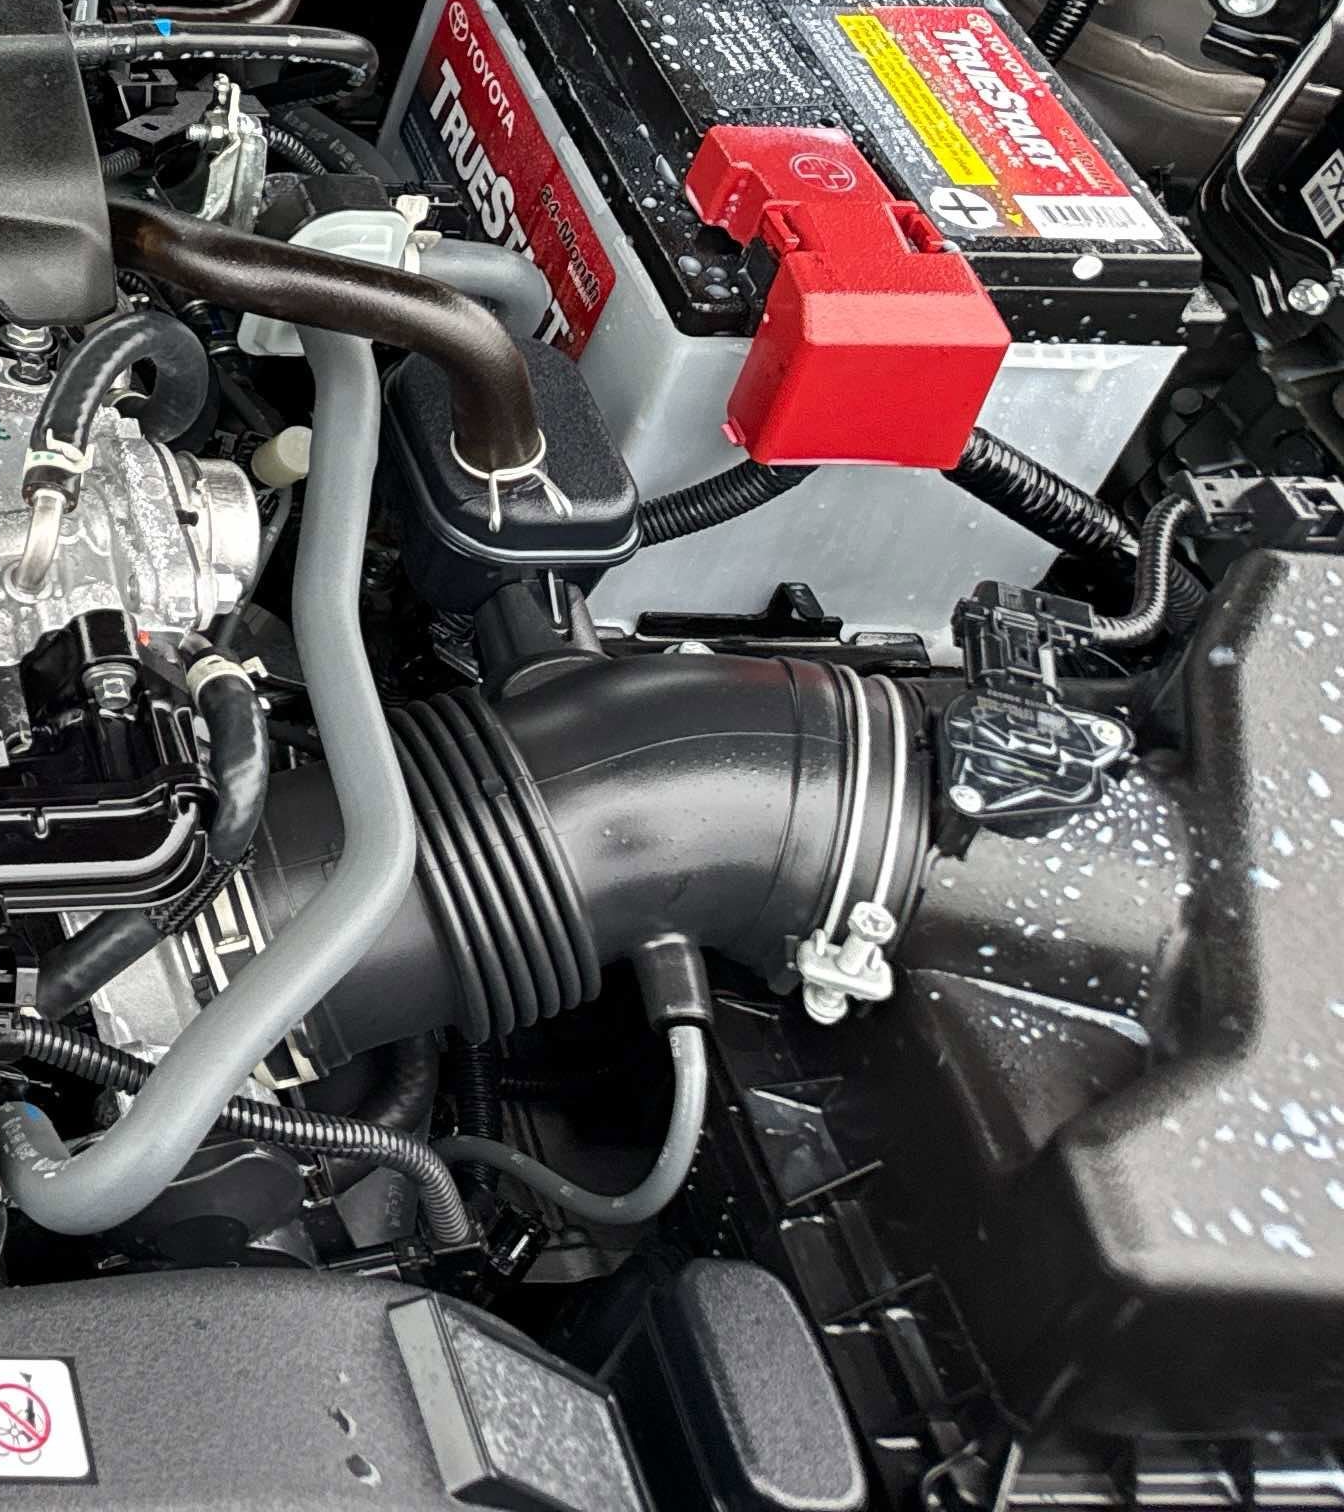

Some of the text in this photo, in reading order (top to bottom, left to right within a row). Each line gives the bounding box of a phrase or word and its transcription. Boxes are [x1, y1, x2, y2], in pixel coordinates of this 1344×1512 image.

[466, 36, 516, 138] TOYOTA
[985, 34, 1038, 91] TOYOTA
[539, 184, 602, 306] 84-Month
